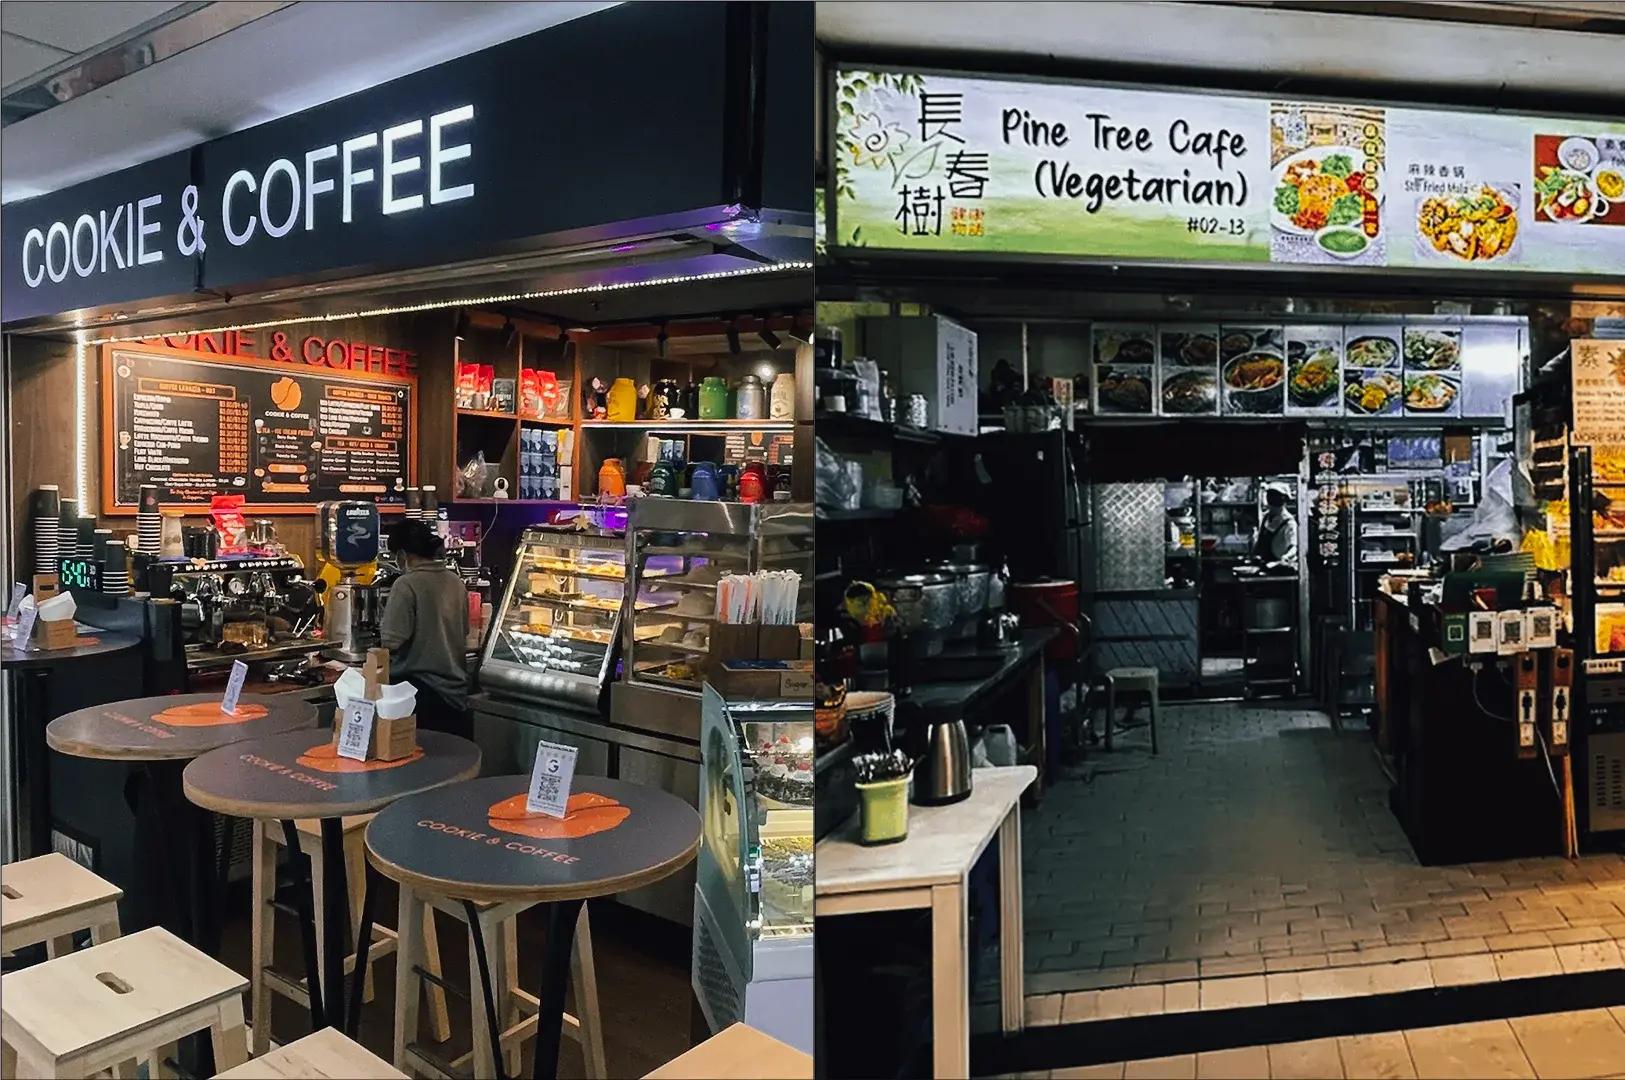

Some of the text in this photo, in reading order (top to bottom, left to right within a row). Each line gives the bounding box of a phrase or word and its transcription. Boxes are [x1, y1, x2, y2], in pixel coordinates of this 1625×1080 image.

[1002, 109, 1247, 169] Pine Tree Cafe
[1034, 159, 1249, 214] (Vegetarian)
[1408, 164, 1465, 179] 麻辣香锅
[22, 104, 475, 288] COOKIE & COFFEE
[1187, 217, 1246, 236] #02-13
[271, 331, 295, 362] &
[417, 819, 581, 865] COOKIE & COFFEE
